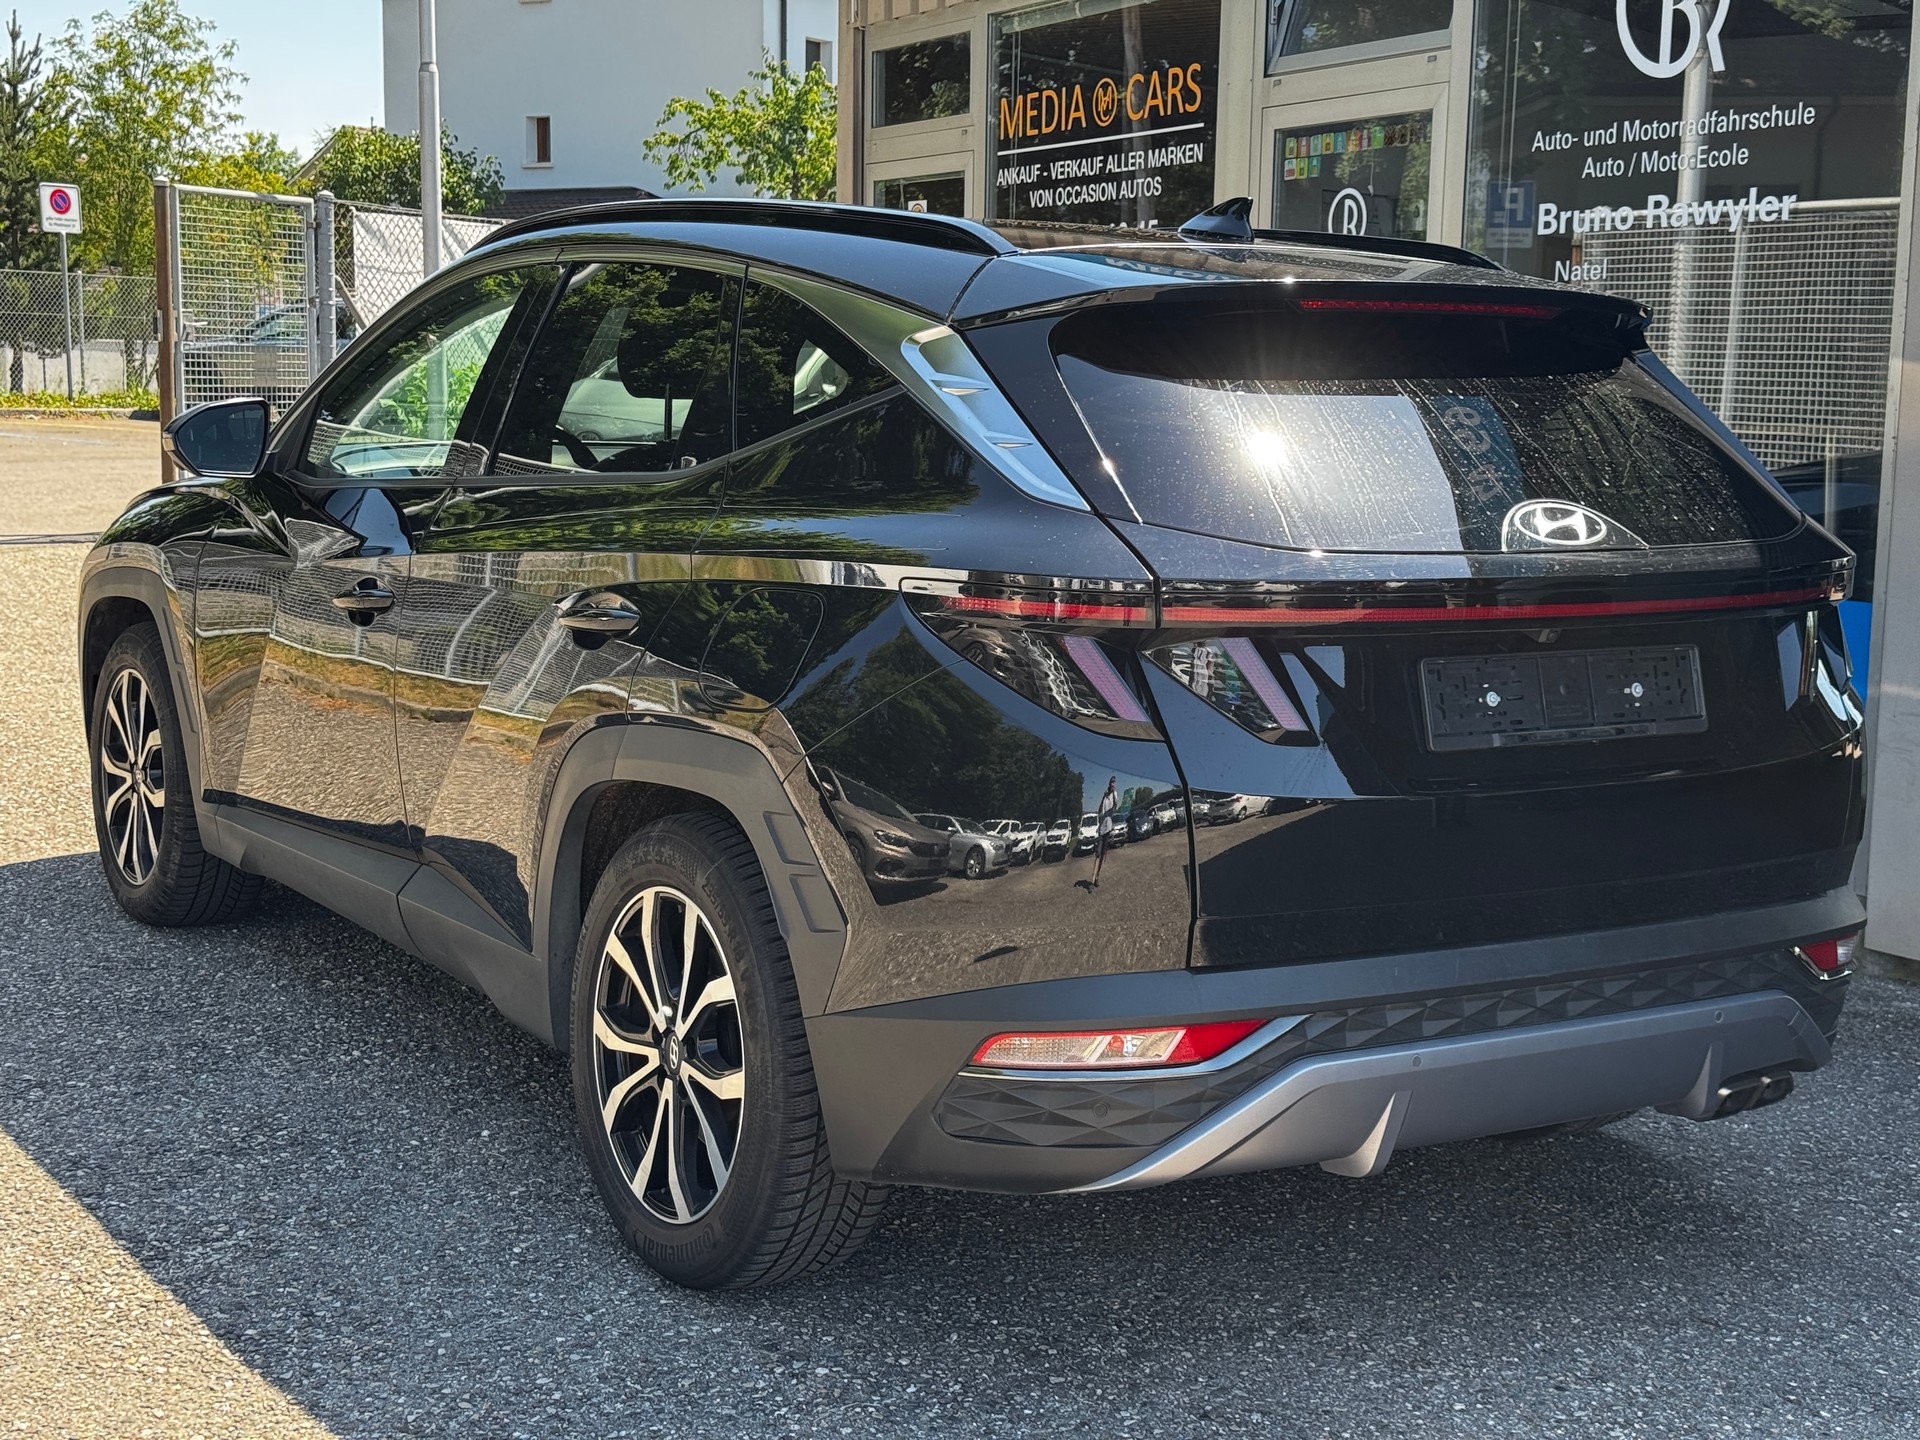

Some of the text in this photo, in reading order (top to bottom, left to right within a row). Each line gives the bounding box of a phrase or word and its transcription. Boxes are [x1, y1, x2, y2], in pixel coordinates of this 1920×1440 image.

[1000, 84, 1086, 140] MEDIA
[1126, 63, 1201, 121] CARS
[1531, 101, 1817, 153] Auto- und Motorradfahrschule
[997, 163, 1041, 187] ANKAUF
[1050, 156, 1104, 180] VERKAUF
[1106, 151, 1145, 174] ALLER
[1148, 142, 1204, 167] MARKEN
[1581, 157, 1625, 180] Auto
[1628, 153, 1638, 178] /
[1029, 176, 1162, 209] VON OCCASION AUTOS
[1537, 187, 1797, 237] Bruno Rawyler
[1554, 260, 1608, 283] Natel
